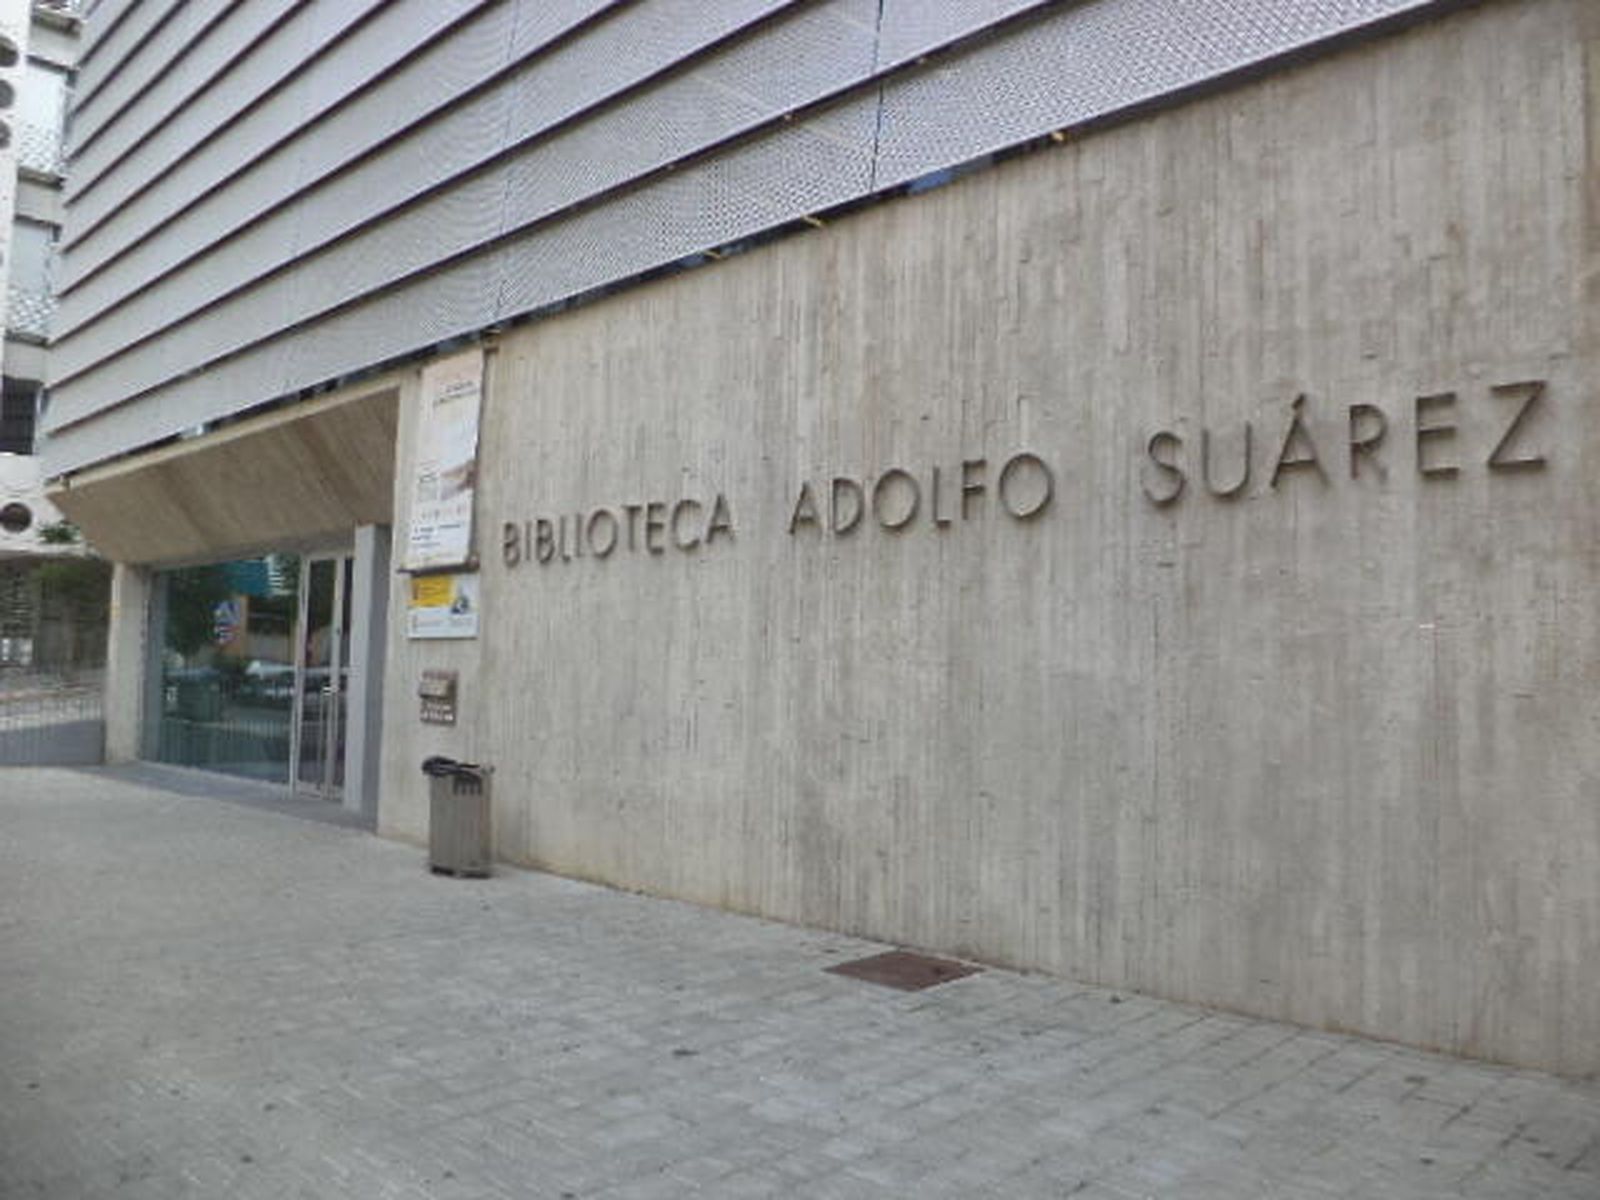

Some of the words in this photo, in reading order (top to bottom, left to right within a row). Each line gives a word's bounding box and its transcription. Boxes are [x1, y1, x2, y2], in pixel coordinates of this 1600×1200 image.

[503, 493, 735, 566] BIBLIOTECA
[788, 453, 1055, 536] ADOLFO
[1142, 380, 1548, 508] SUÁREZ
